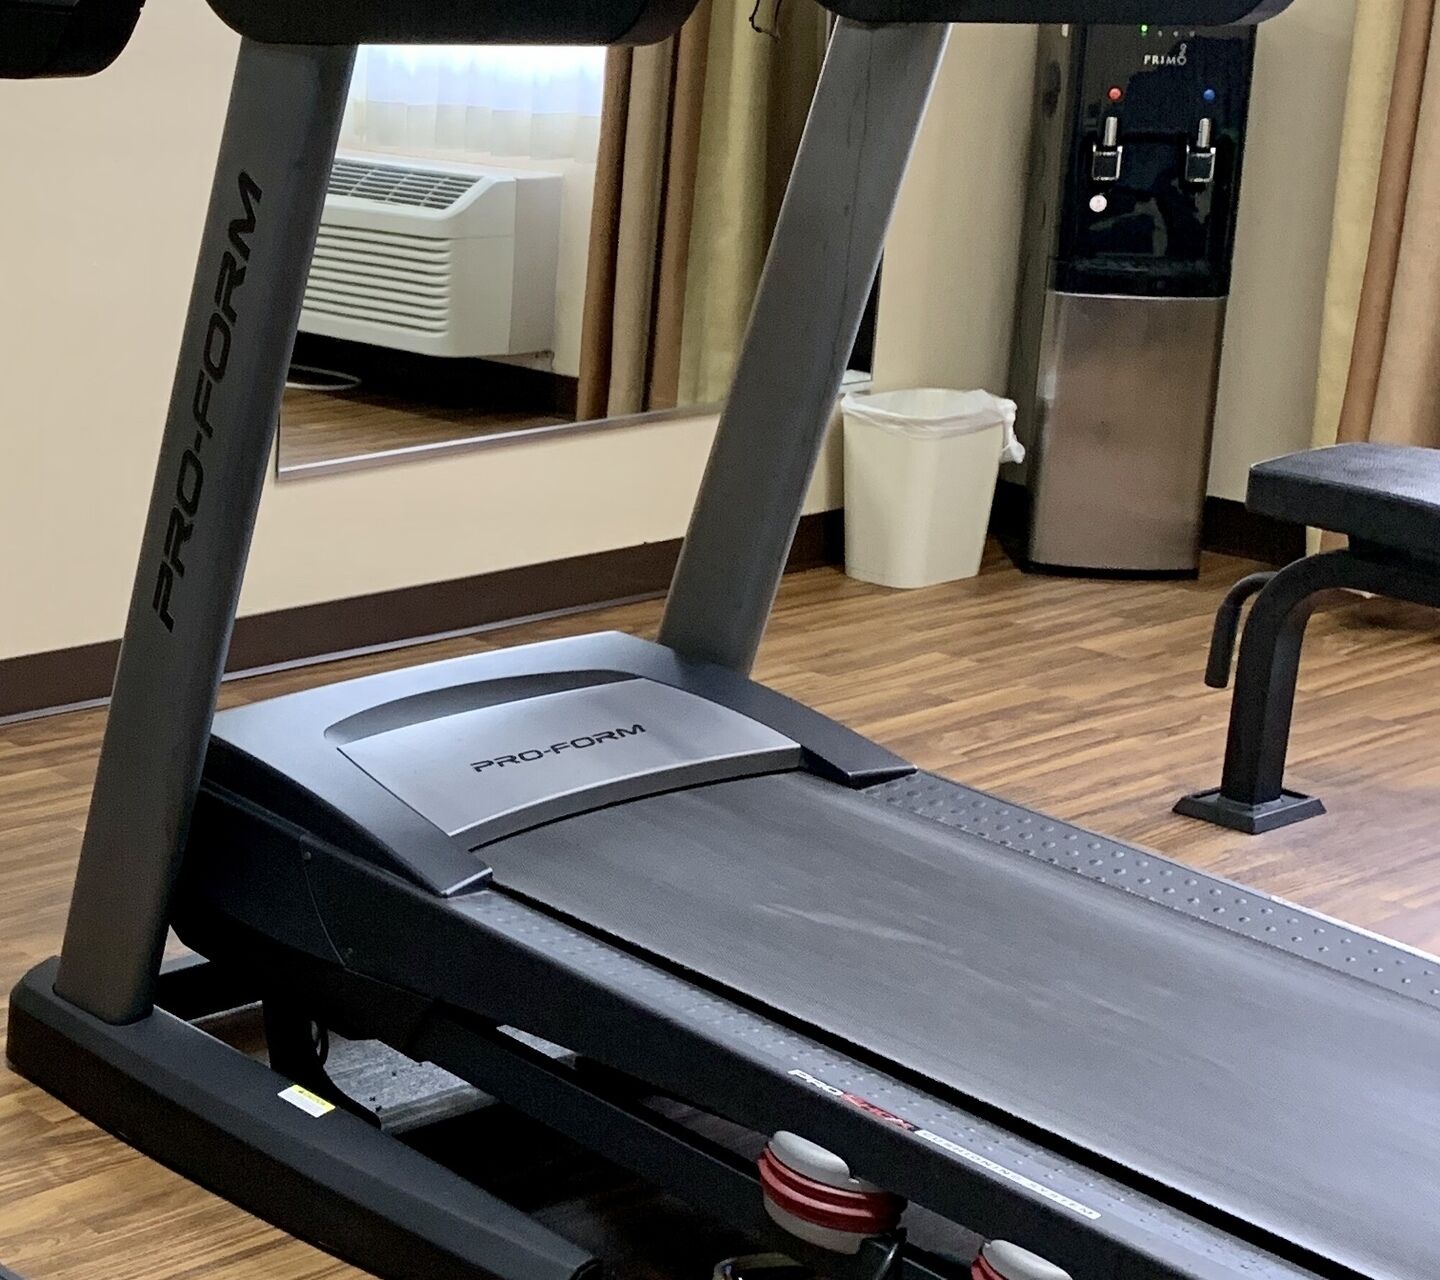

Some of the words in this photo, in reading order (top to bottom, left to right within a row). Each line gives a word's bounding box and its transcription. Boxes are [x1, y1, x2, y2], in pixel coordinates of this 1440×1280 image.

[1143, 50, 1188, 66] PRIMO
[152, 169, 262, 634] PRO-FORM
[470, 723, 647, 773] PRO-FORM
